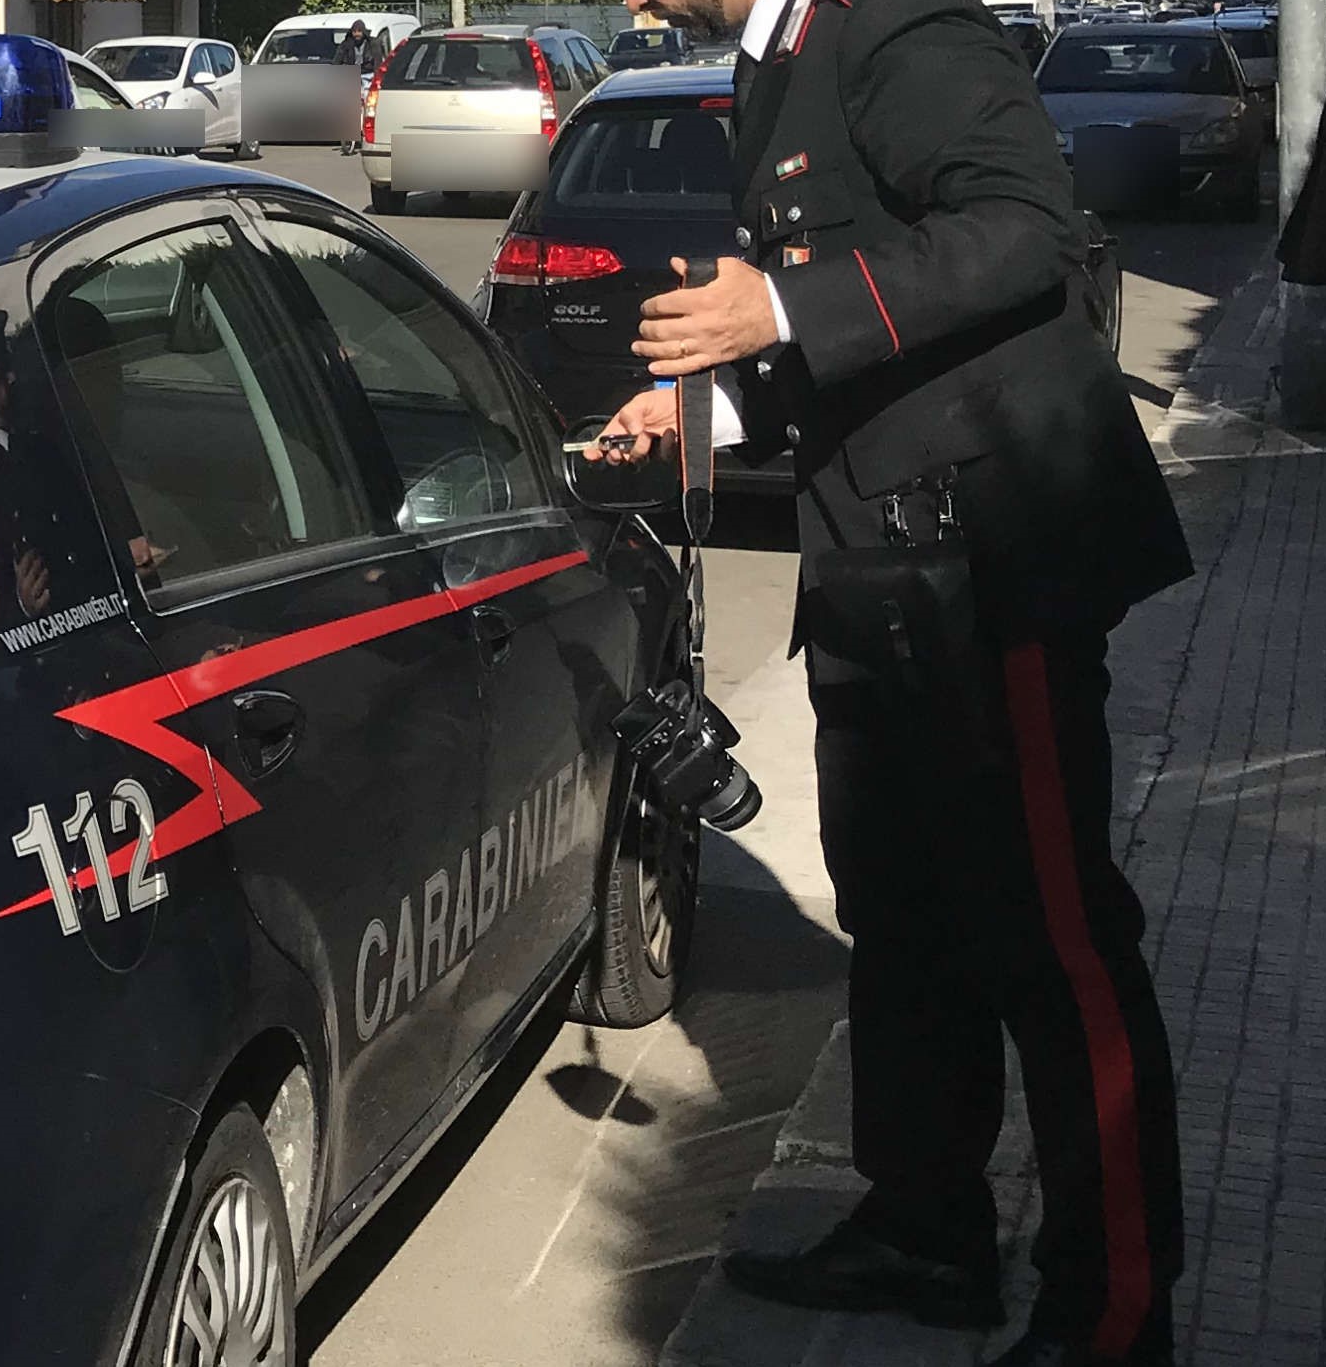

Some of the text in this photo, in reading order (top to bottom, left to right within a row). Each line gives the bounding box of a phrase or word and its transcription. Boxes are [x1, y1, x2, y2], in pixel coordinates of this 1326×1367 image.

[553, 304, 601, 316] GOLF
[0, 592, 124, 654] WWW.CARABINIERI.IT
[11, 778, 170, 937] 112
